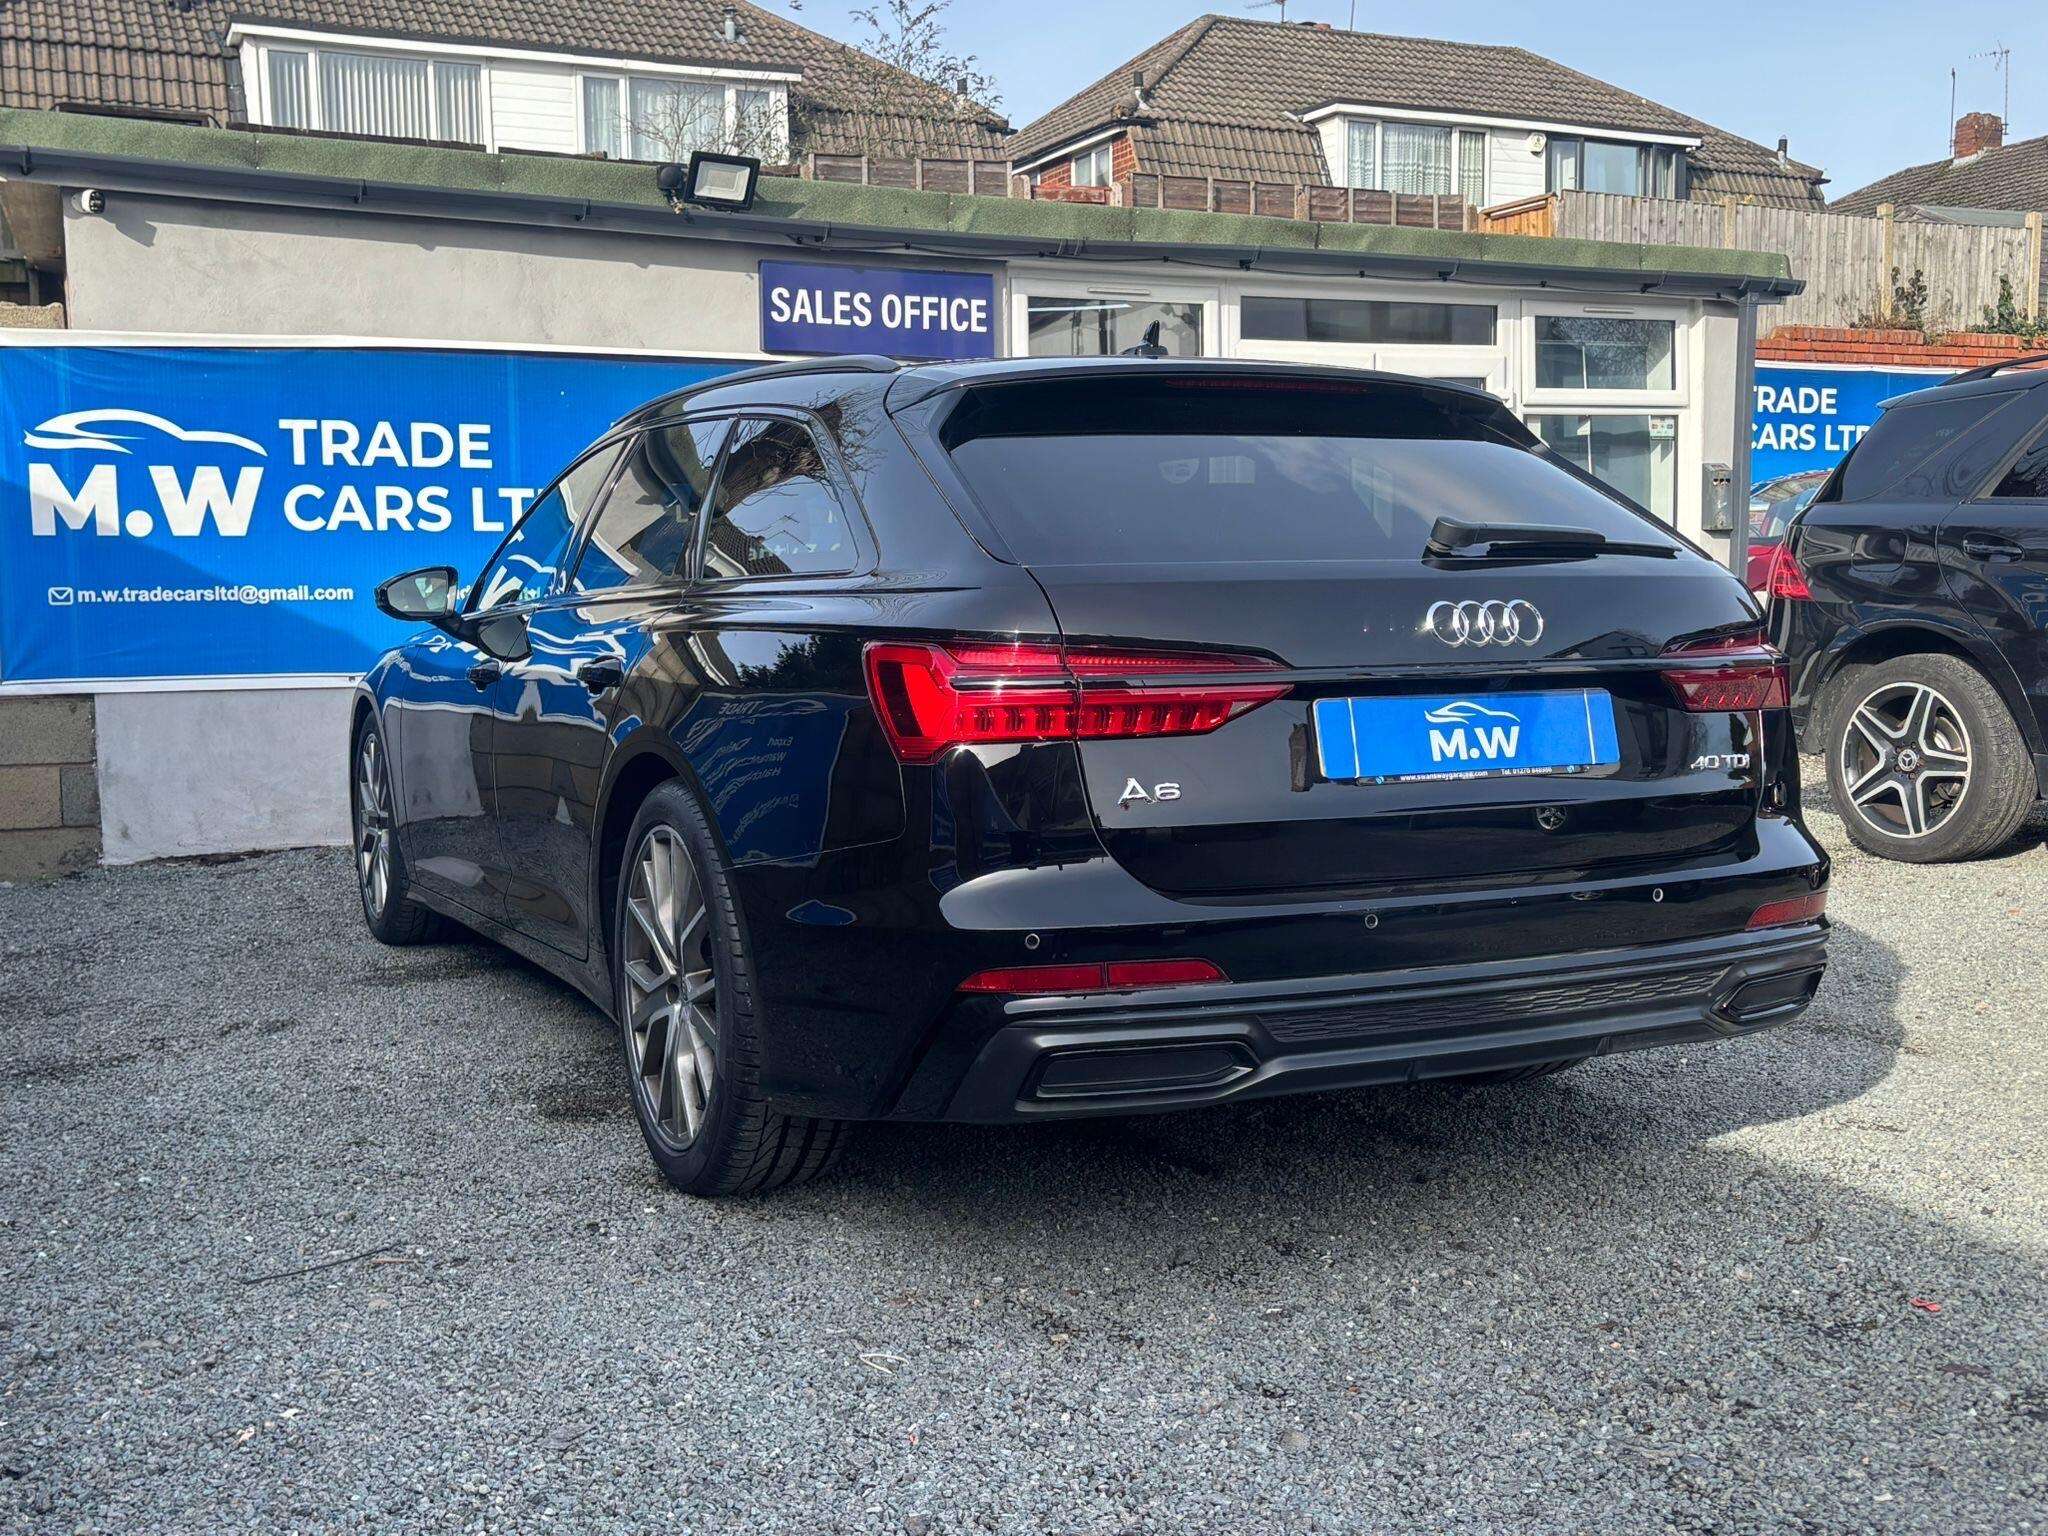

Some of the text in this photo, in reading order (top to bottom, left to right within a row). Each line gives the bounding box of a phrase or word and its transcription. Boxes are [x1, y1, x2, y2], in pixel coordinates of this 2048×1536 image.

[771, 286, 988, 333] SALES OFFICE
[278, 418, 492, 470] TRADE
[27, 463, 264, 537] M.W
[282, 485, 546, 533] CARS LT
[77, 586, 354, 604] m.w.tradecarsltd@gmail.com
[1429, 726, 1520, 762] M.W
[1690, 754, 1720, 769] 40
[1118, 777, 1182, 805] A6
